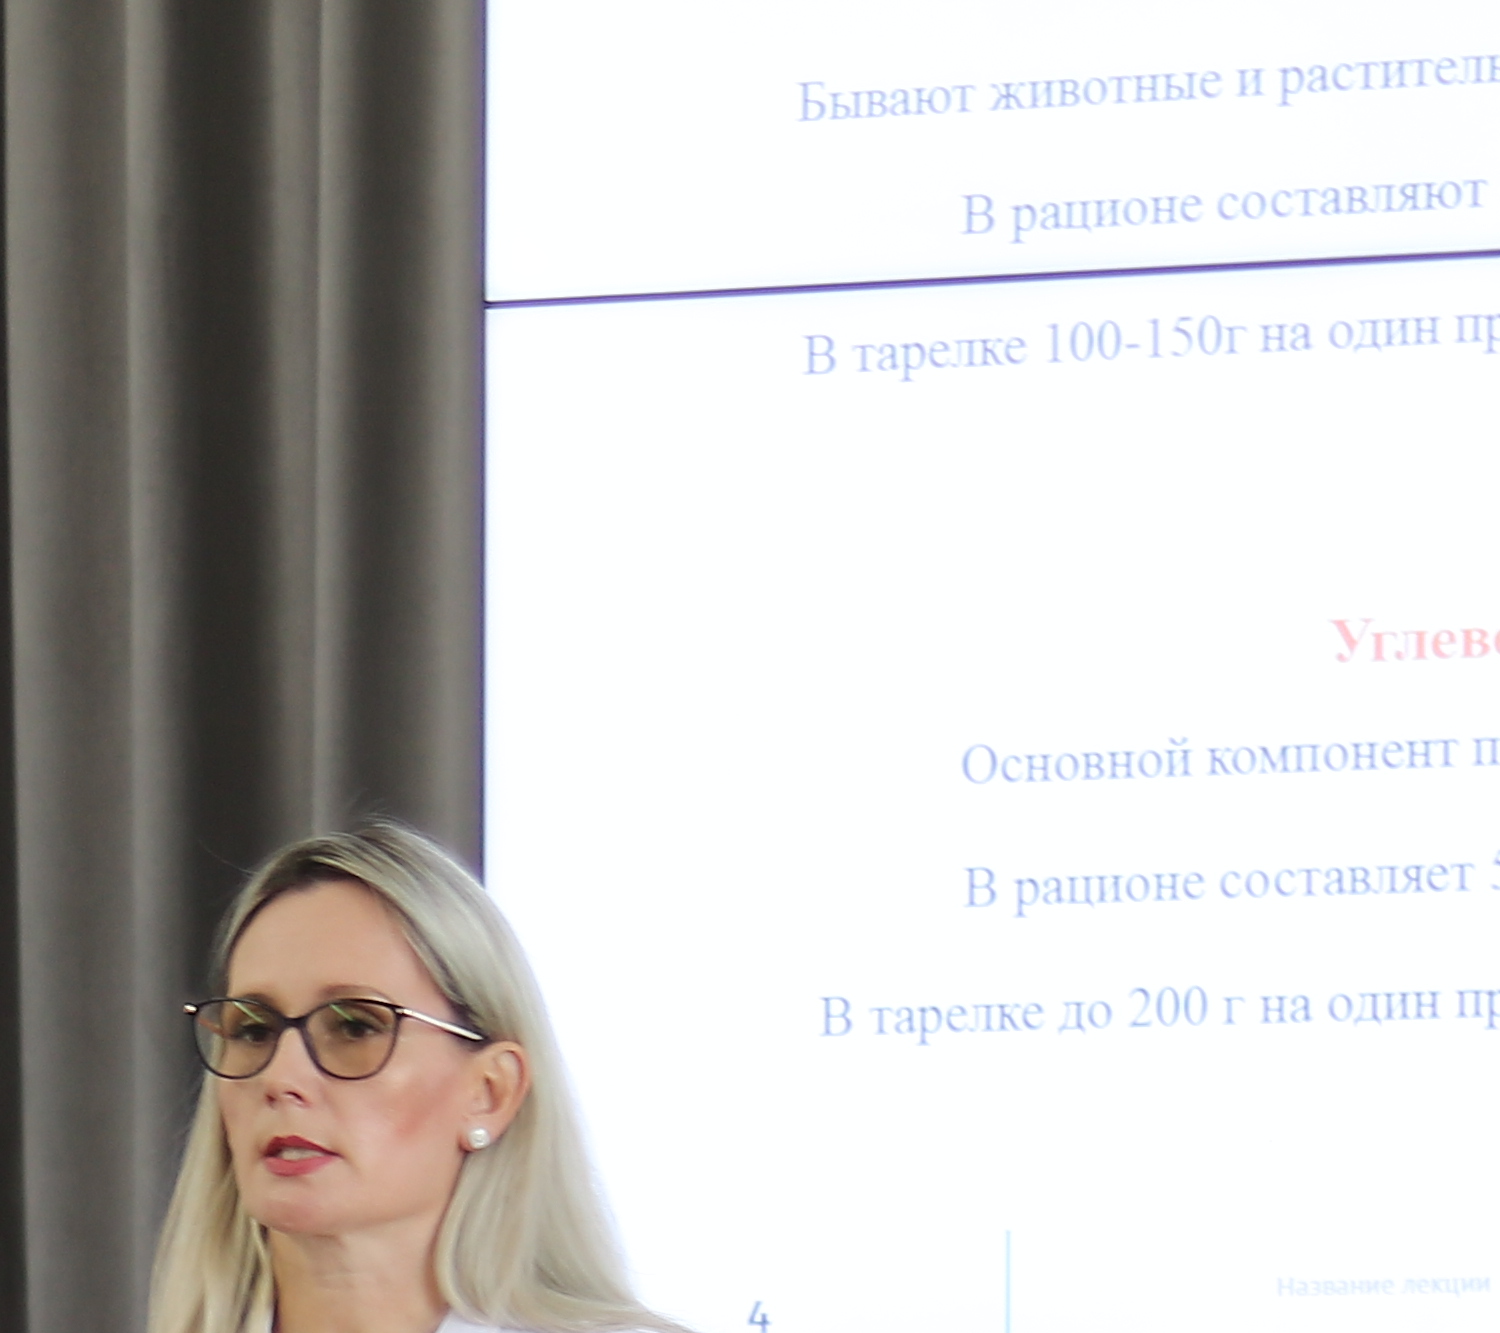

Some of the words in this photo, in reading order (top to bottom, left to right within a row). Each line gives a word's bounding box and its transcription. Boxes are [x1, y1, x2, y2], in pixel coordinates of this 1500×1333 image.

[798, 80, 976, 122] Бывают
[989, 69, 1223, 112] животные
[1236, 67, 1265, 98] и
[962, 194, 996, 235] В
[1010, 194, 1203, 243] рационе
[1216, 179, 1488, 221] составляют
[803, 334, 837, 375] В
[852, 337, 1028, 383] тарелке
[1048, 315, 1248, 364] 100-150г
[1260, 322, 1314, 353] на
[1328, 316, 1441, 353] один
[961, 736, 1193, 785] Основной
[1207, 738, 1459, 777] компонент
[964, 866, 998, 908] В
[1014, 872, 1205, 918] рационе
[1219, 862, 1475, 900] составляет
[820, 996, 853, 1037] В
[869, 1002, 1045, 1047] тарелке
[1057, 999, 1114, 1034] до
[1128, 985, 1210, 1029] 200
[1223, 996, 1246, 1026] г
[1259, 993, 1314, 1025] на
[1327, 990, 1441, 1026] один
[1276, 1277, 1396, 1297] Название
